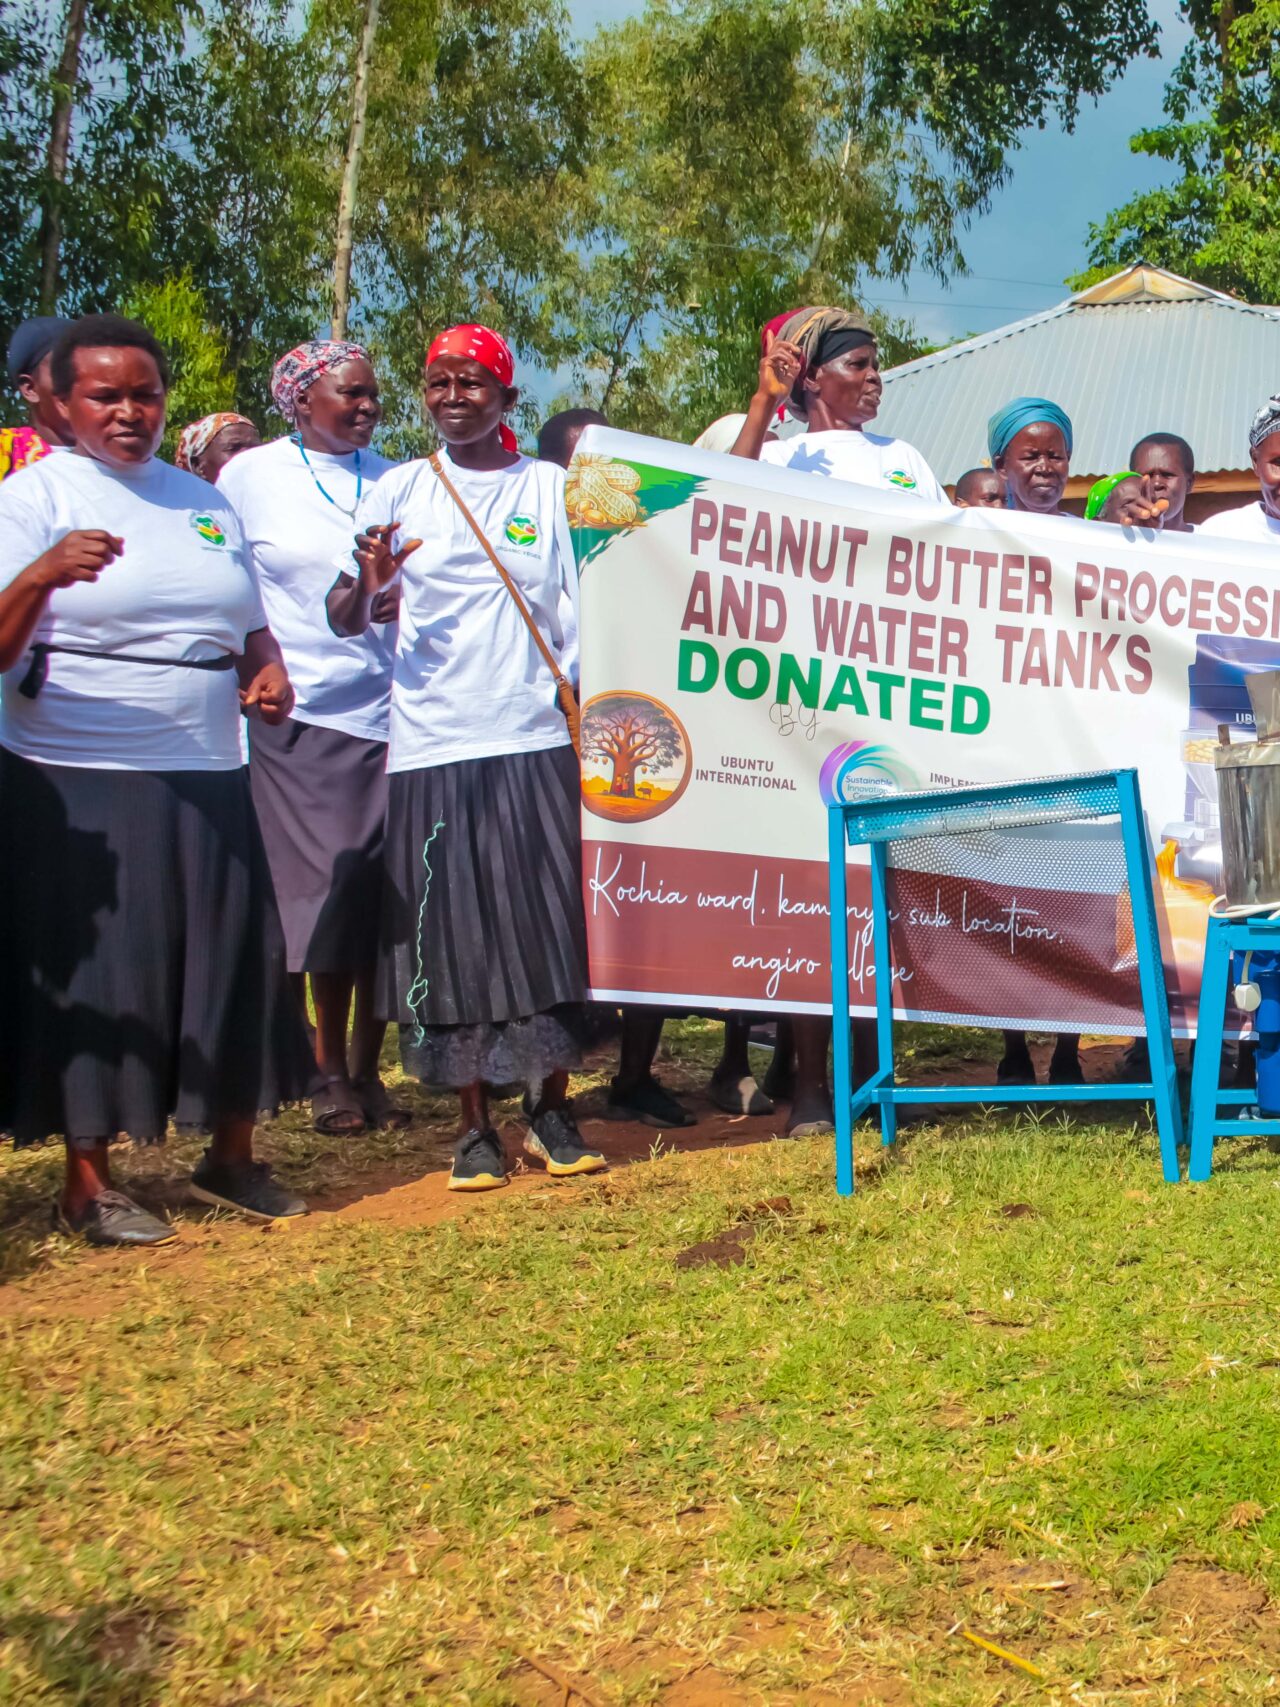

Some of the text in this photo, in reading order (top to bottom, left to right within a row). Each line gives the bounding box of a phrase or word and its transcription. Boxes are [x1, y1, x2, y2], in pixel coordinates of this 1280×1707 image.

[690, 497, 868, 588] PEANUT
[886, 536, 1053, 615] BUTTER
[681, 571, 1153, 694] AND WATER TANKS
[677, 639, 990, 736] DONATED
[695, 769, 797, 791] INTERNATIONAL
[721, 756, 774, 772] UBUNTU
[845, 775, 893, 786] Sustainable
[589, 848, 688, 917] Kochia
[909, 888, 953, 928] sub
[732, 948, 821, 998] angiro
